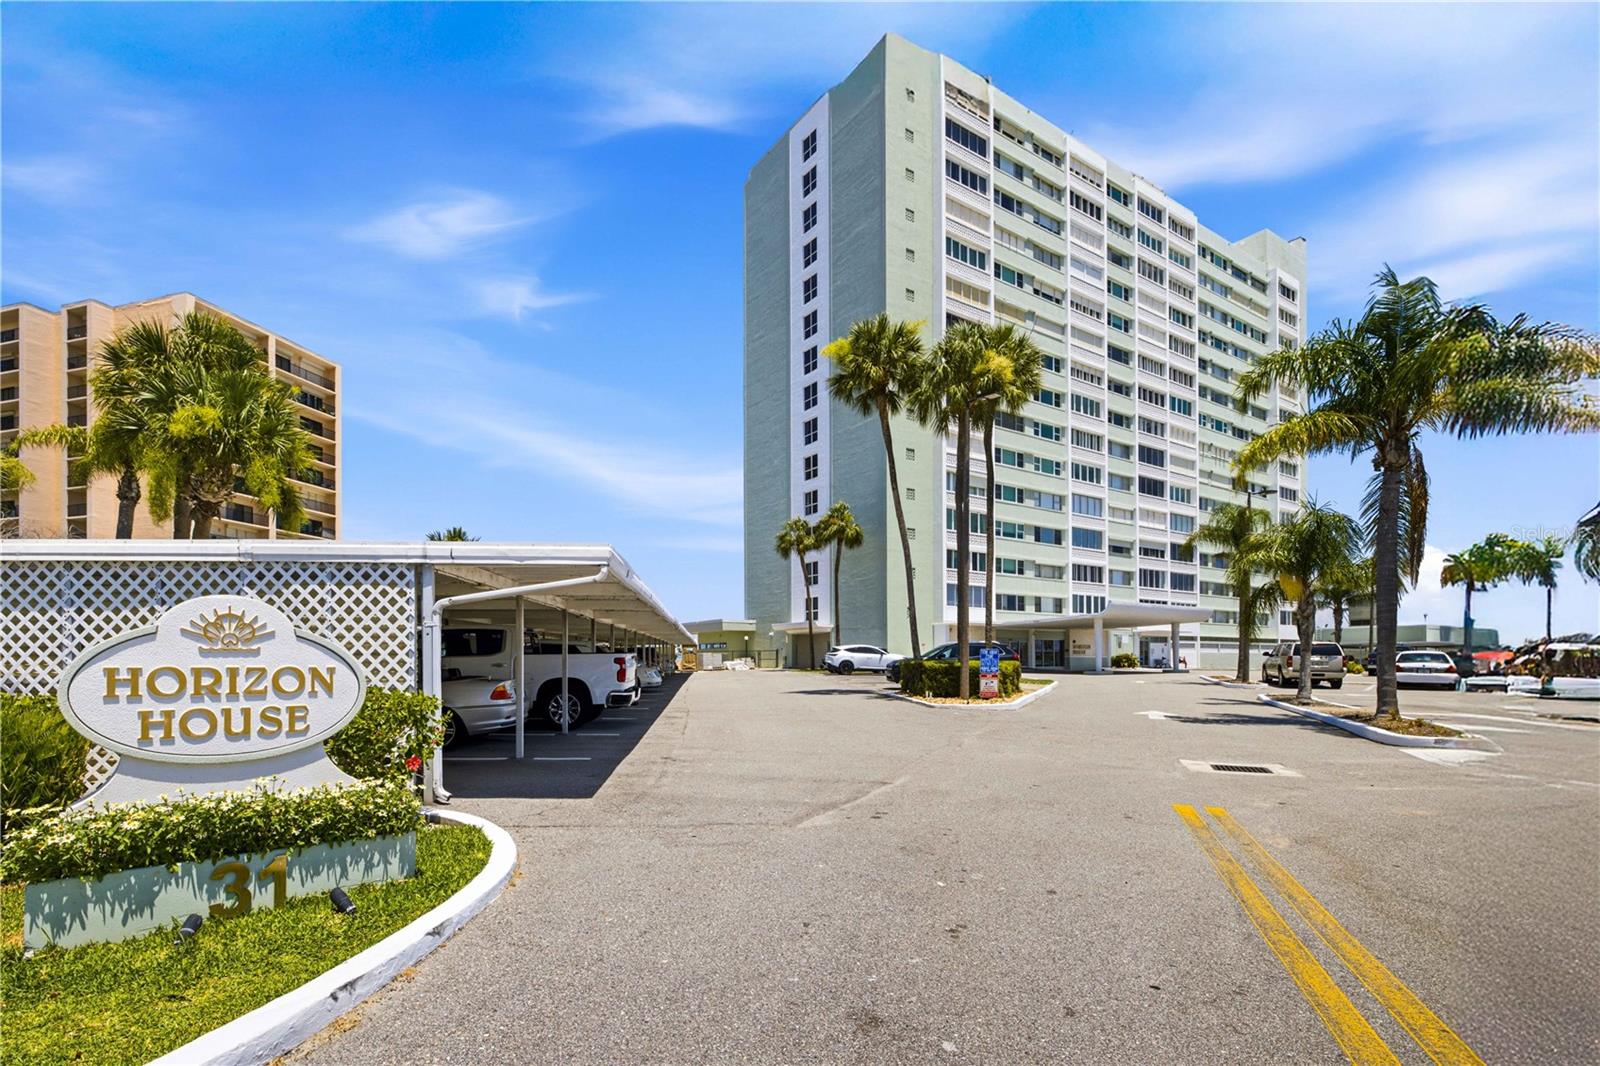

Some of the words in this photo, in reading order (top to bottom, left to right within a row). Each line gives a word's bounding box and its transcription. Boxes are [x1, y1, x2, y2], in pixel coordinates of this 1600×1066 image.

[102, 665, 336, 703] HORIZON
[137, 704, 311, 745] HOUSE
[208, 855, 288, 919] 31
